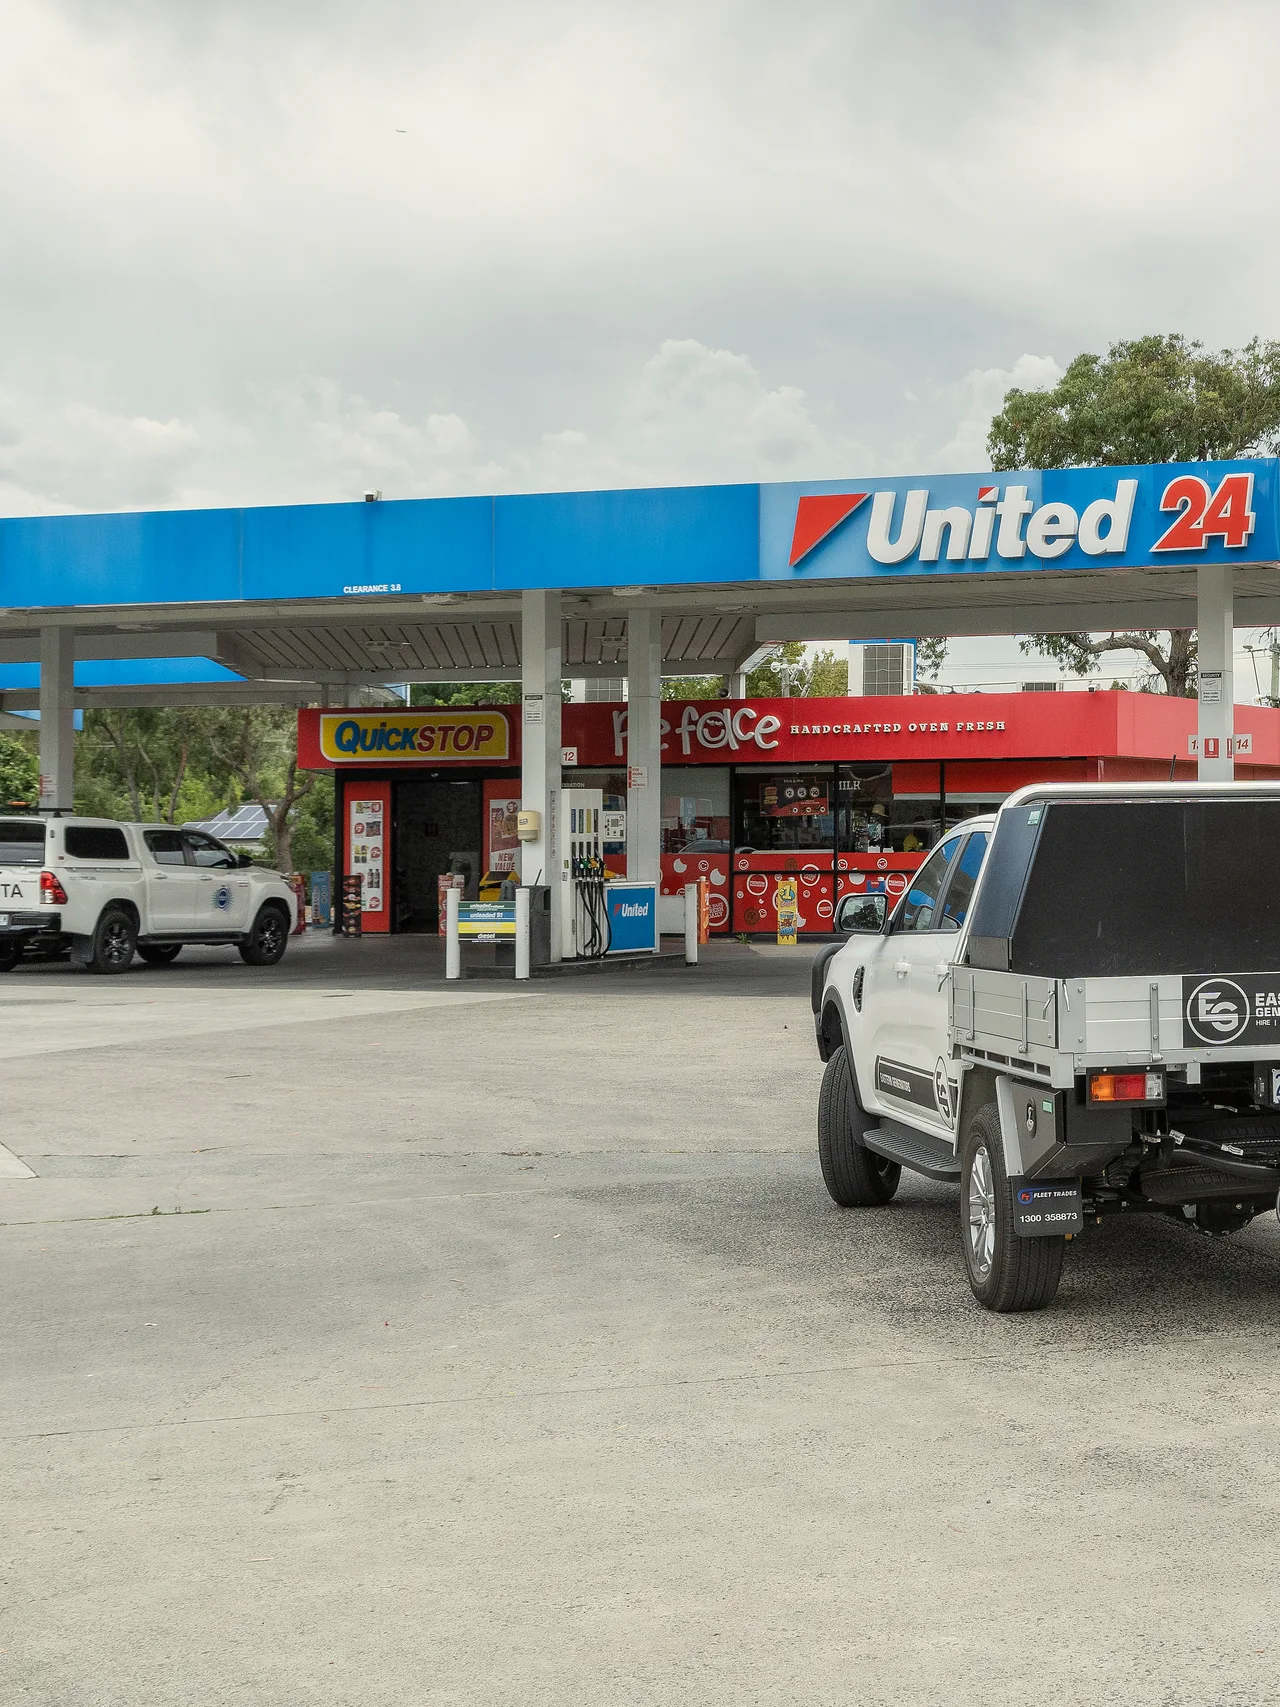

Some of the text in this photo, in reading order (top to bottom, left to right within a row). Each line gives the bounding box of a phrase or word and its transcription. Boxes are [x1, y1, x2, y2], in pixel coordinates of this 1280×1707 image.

[866, 472, 1257, 564] United 24
[343, 583, 402, 594] CLEARANCE 3.8
[675, 705, 781, 755] face
[790, 721, 1006, 734] HANDCRAFTED OVEN FRESH
[1191, 739, 1198, 750] 1
[1236, 739, 1249, 750] 14
[563, 751, 575, 761] 12
[498, 853, 514, 861] NEW
[495, 862, 516, 870] VALUE
[621, 902, 649, 917] United
[1019, 1212, 1078, 1223] 1300 358873
